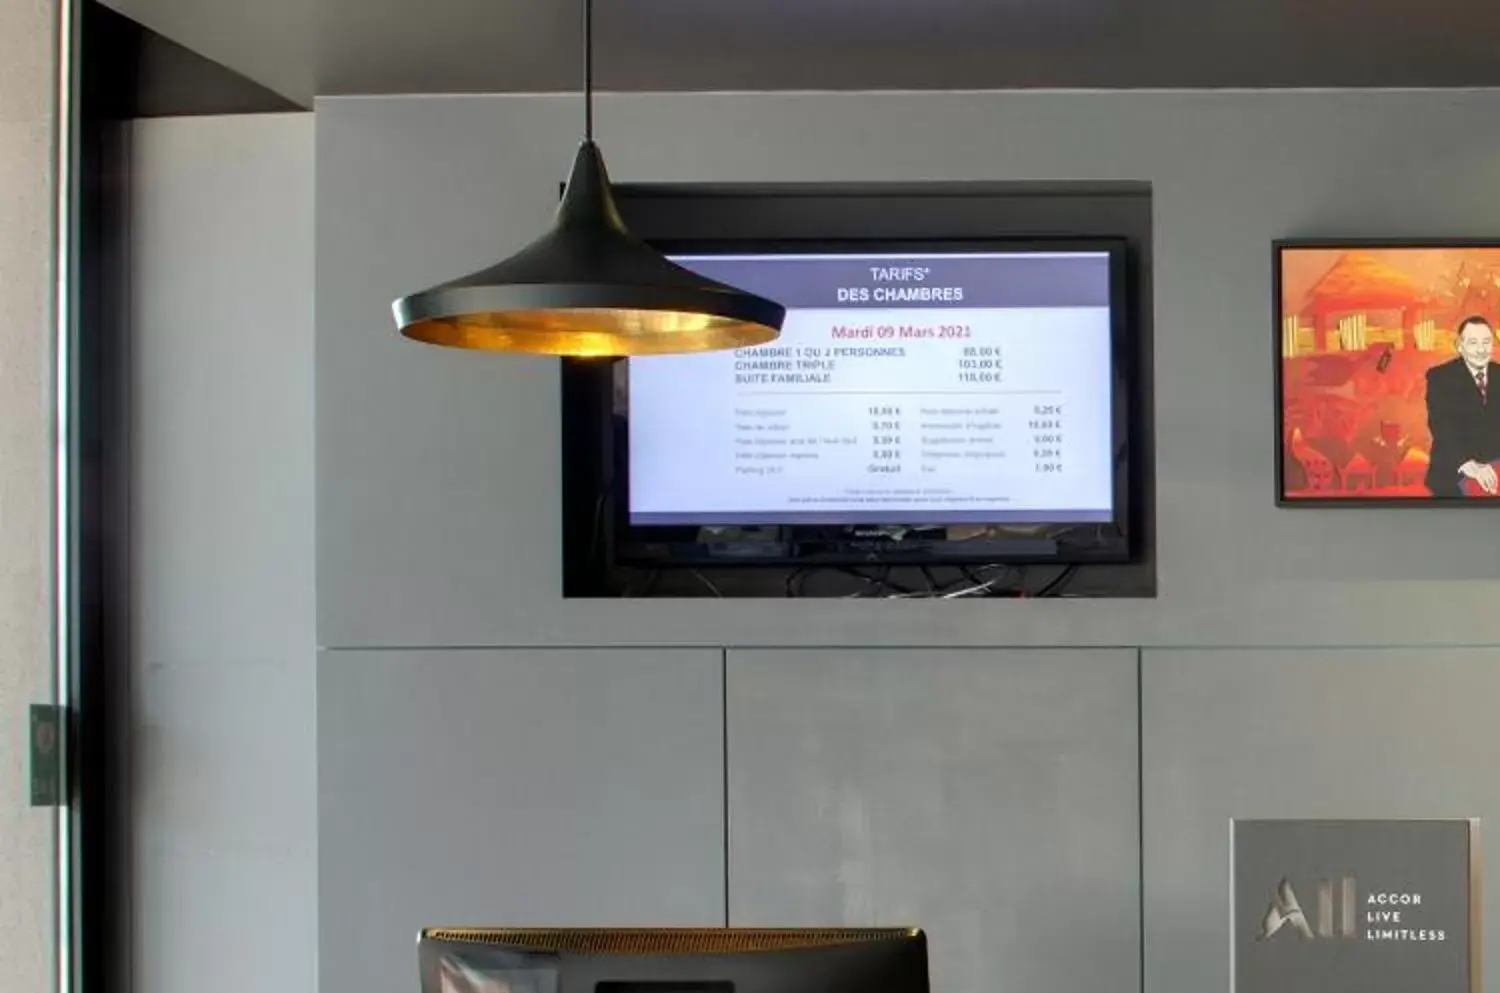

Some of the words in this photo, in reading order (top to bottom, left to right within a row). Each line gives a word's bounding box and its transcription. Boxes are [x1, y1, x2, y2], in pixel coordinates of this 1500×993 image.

[837, 287, 869, 302] DES
[873, 287, 963, 302] CHAMBRES
[831, 325, 873, 339] Mardi
[877, 325, 896, 339] 09
[899, 325, 935, 339] Mars
[938, 325, 972, 339] 2021
[735, 360, 792, 371] CHAMBRE
[1367, 893, 1422, 906] ACCOR
[1367, 911, 1402, 923] LIVE
[1367, 929, 1447, 941] LIMITLESS
